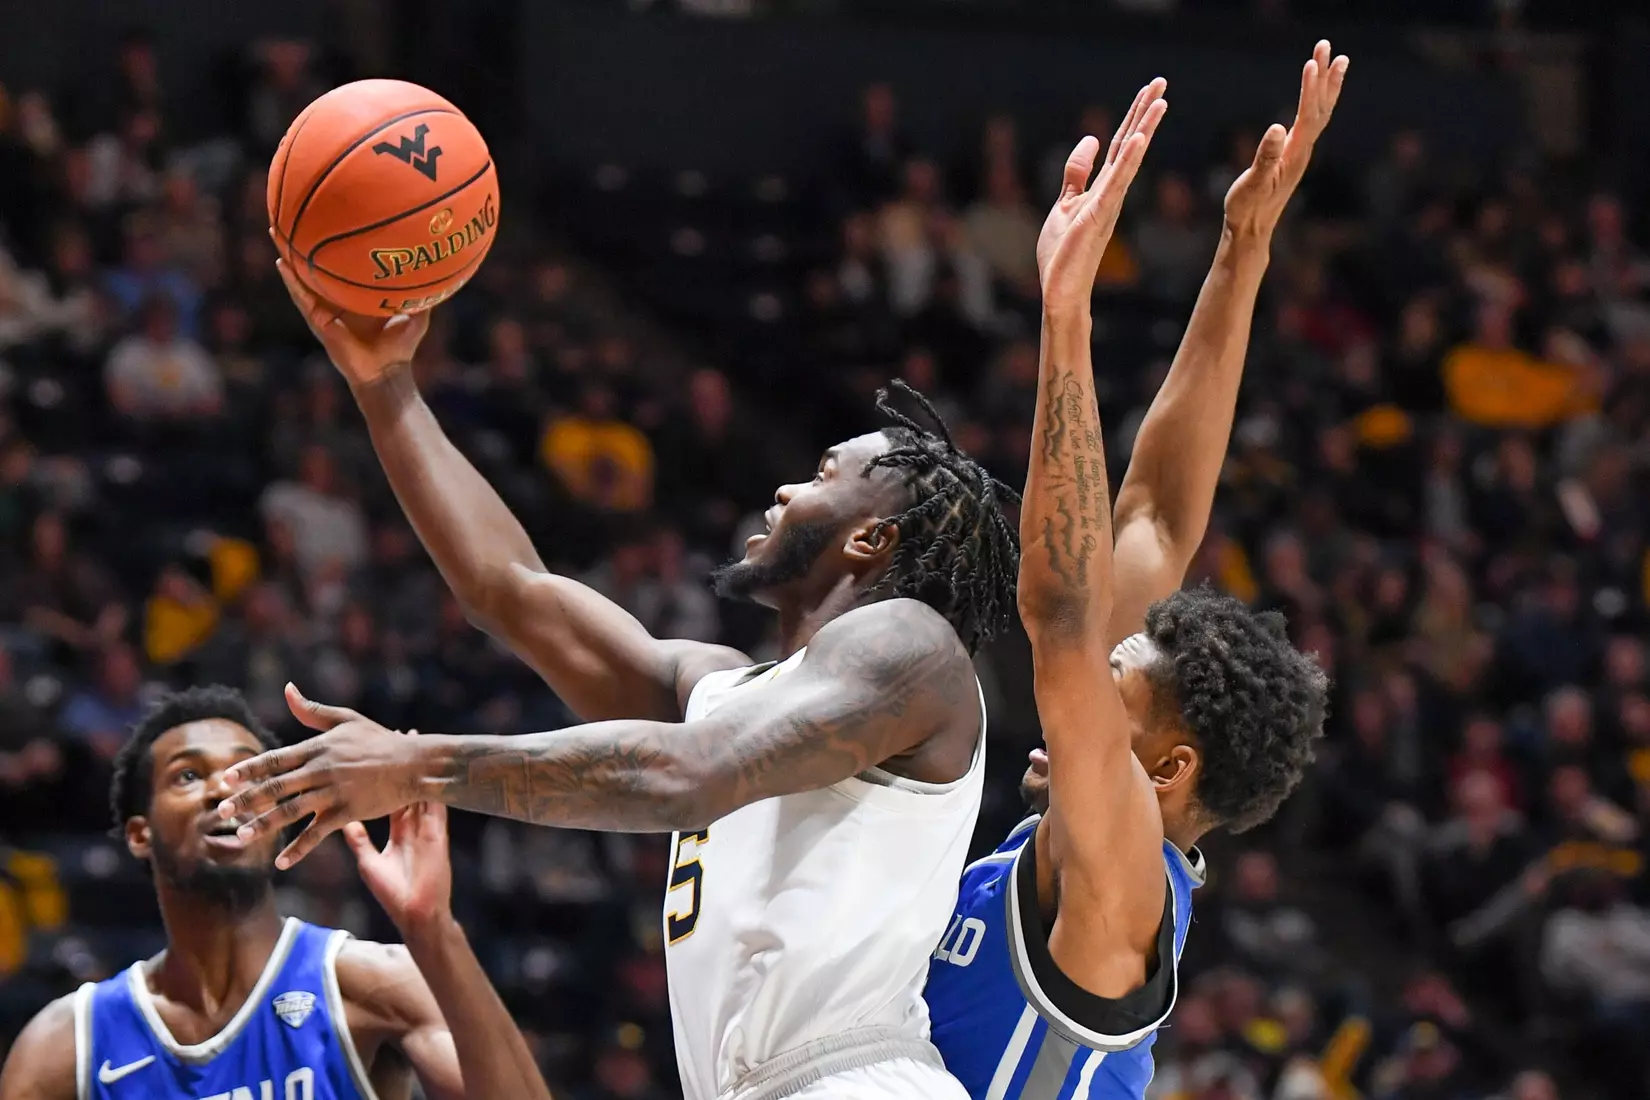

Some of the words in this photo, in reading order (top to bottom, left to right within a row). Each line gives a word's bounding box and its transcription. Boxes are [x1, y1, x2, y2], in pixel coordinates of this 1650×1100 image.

[369, 193, 496, 281] SPALDING
[667, 828, 709, 946] 5
[933, 913, 986, 967] LO
